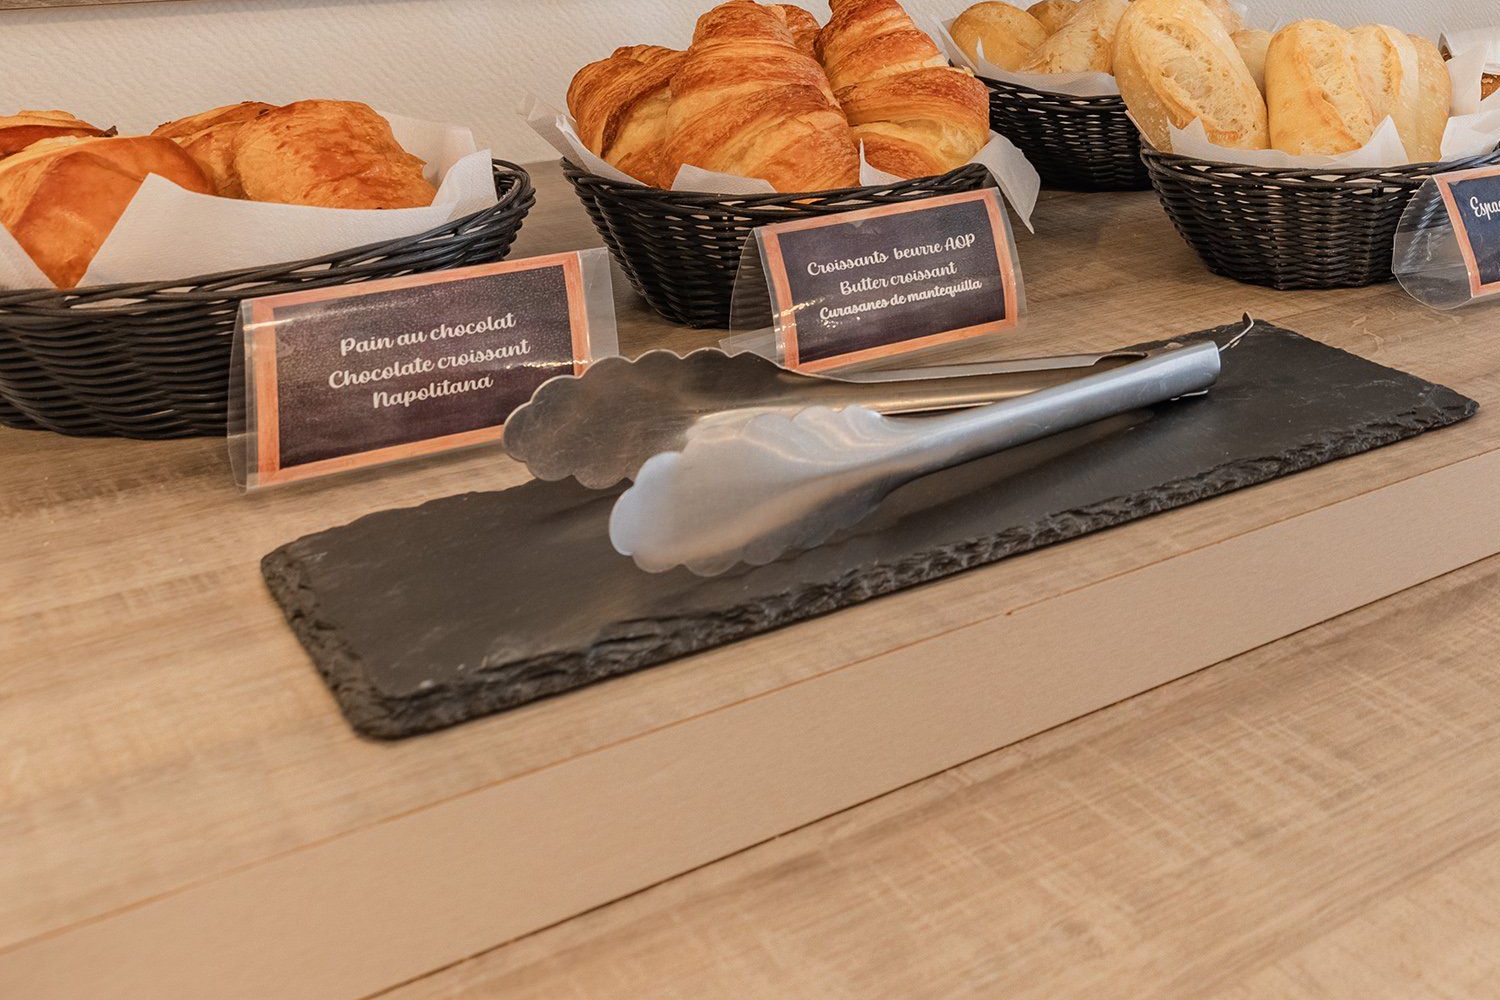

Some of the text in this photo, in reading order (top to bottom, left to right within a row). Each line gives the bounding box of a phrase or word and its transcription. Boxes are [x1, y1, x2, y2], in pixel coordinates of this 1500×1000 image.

[807, 233, 976, 276] Croissants beurre AOP
[819, 279, 983, 320] Curasanes de mantequilla
[840, 261, 959, 296] Butter croissant
[340, 312, 518, 357] Pain au chocolat
[328, 339, 532, 389] Chocolate croissant
[372, 373, 494, 409] Napolitana
